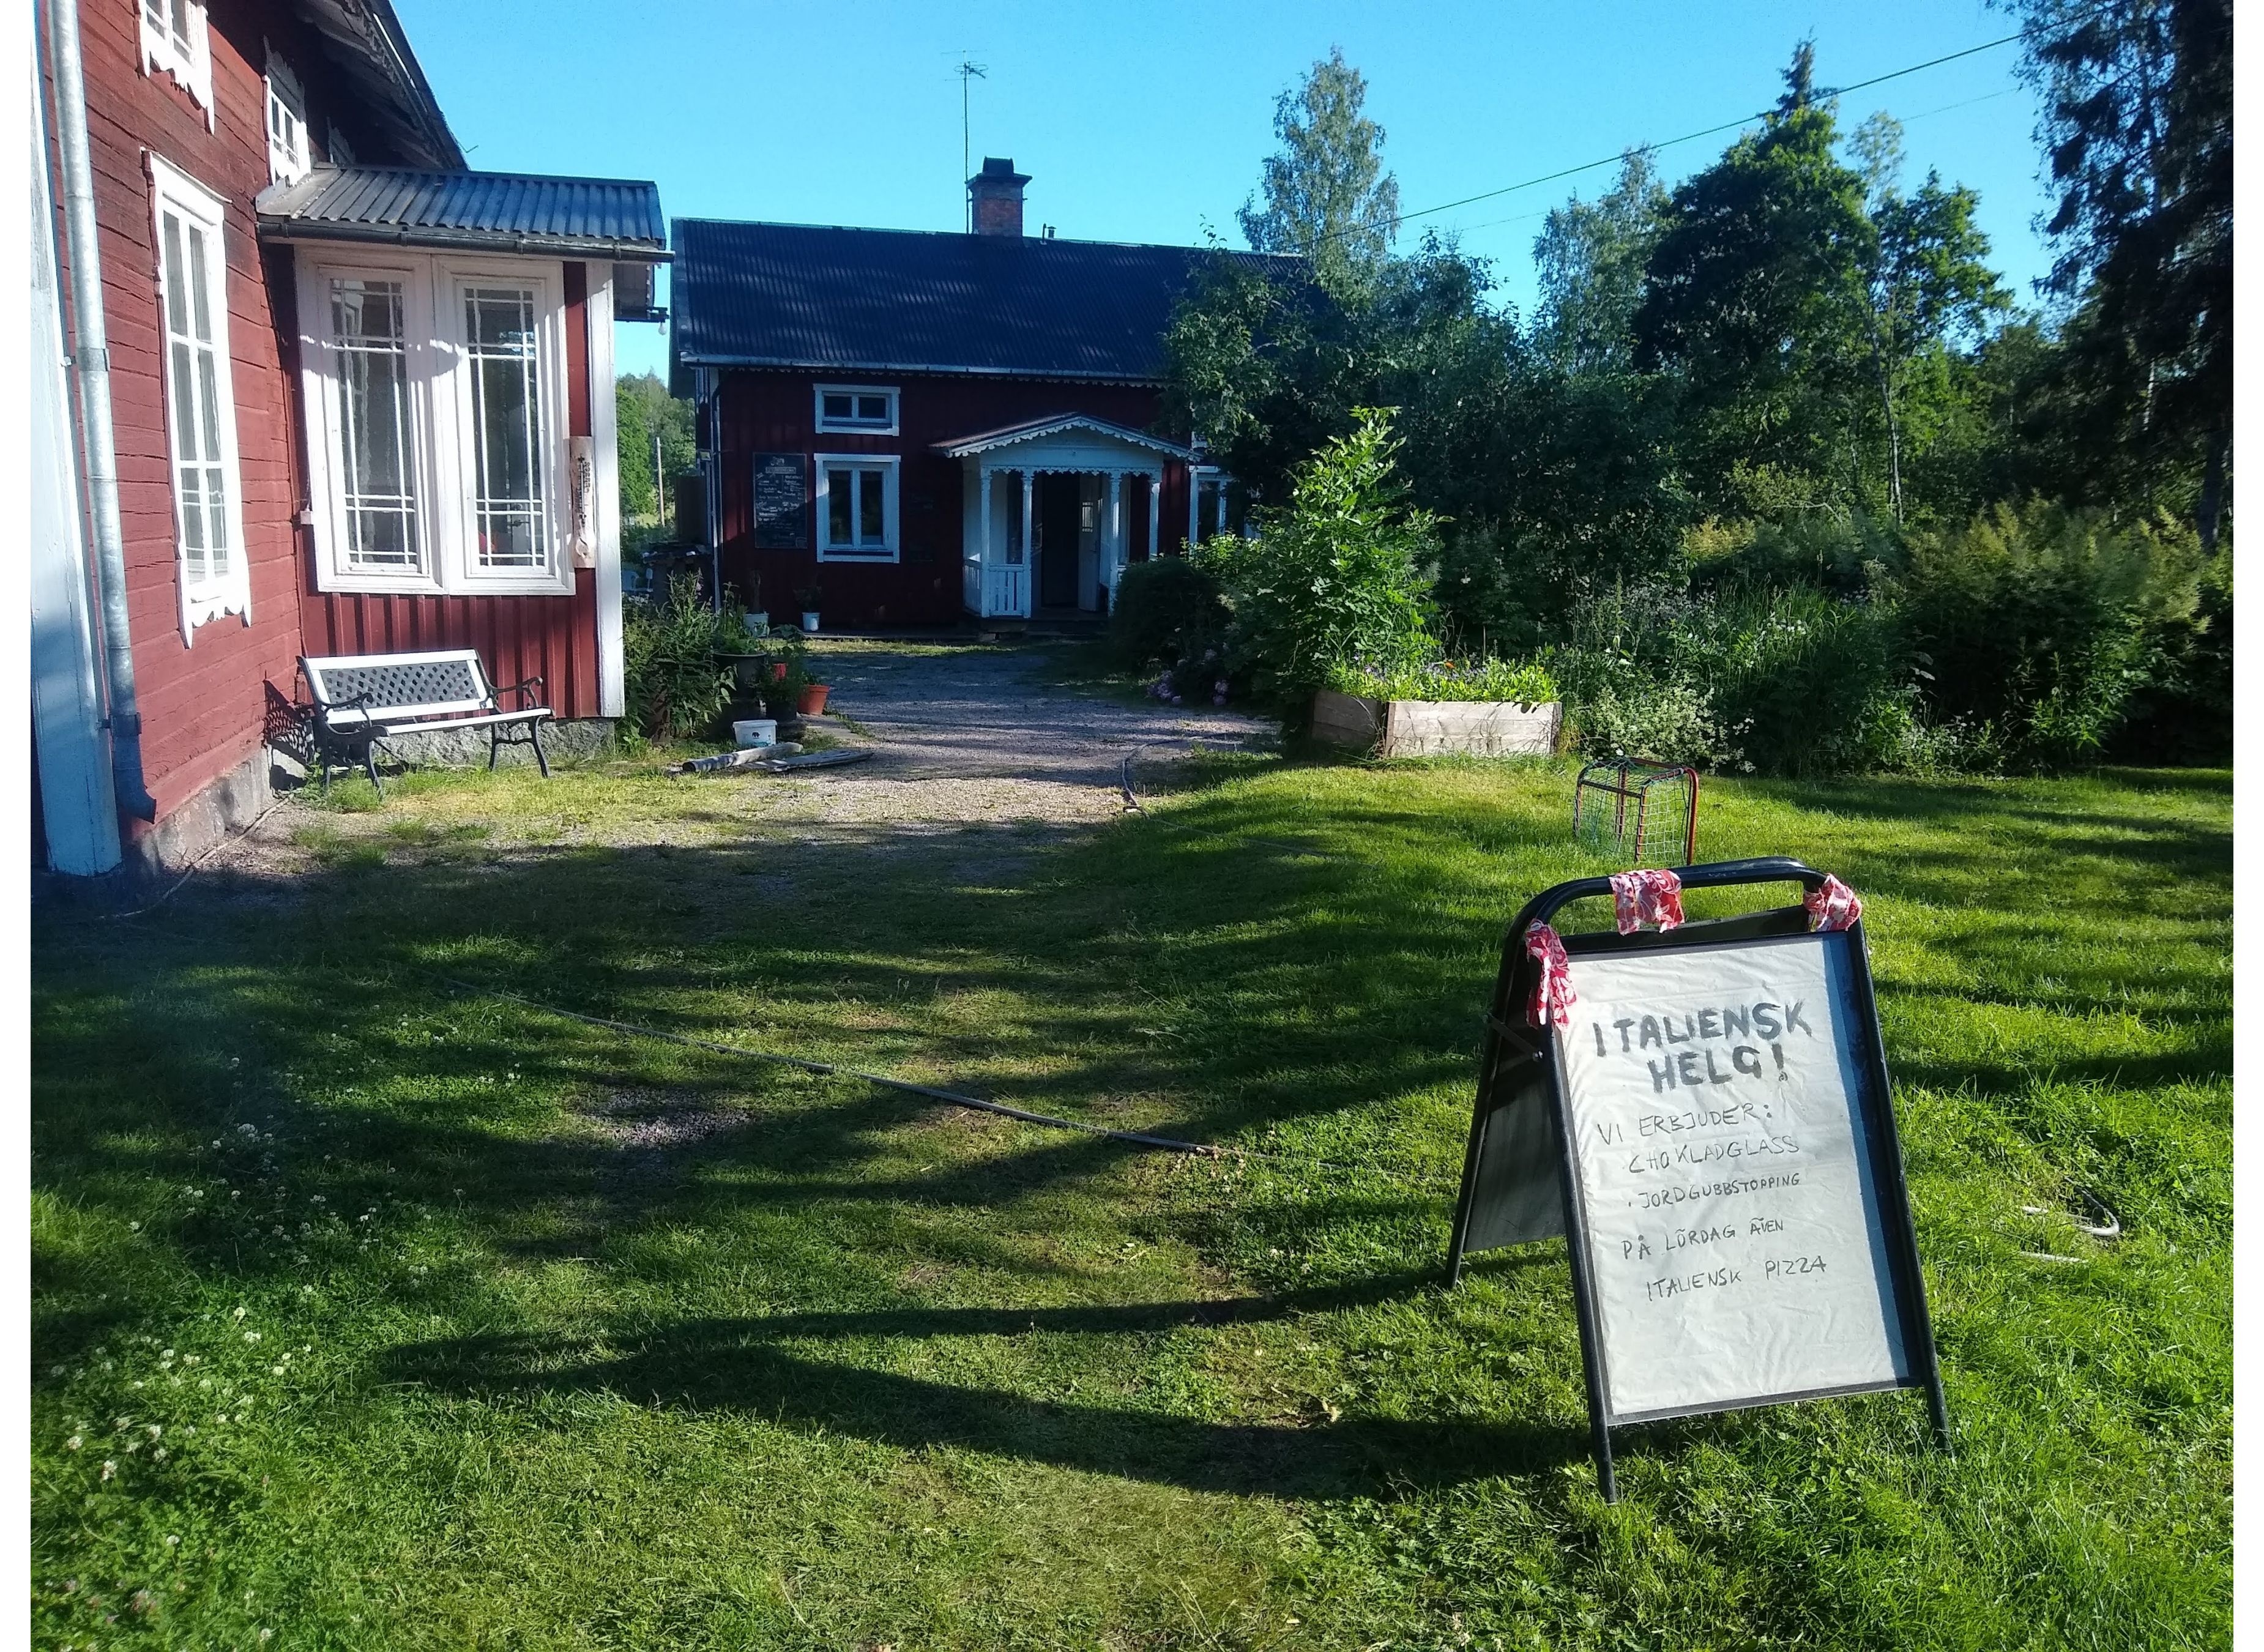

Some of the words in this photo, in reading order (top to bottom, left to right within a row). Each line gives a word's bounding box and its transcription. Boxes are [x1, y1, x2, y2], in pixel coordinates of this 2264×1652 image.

[1592, 999, 1812, 1058] ITALIENSK
[1597, 1122, 1624, 1146] VI
[1628, 1135, 1800, 1174] CHOKLADGLASS
[1622, 1234, 1651, 1260] PÅ
[1647, 1267, 1742, 1301] ITALIENSK
[1765, 1255, 1826, 1280] PIZZA
